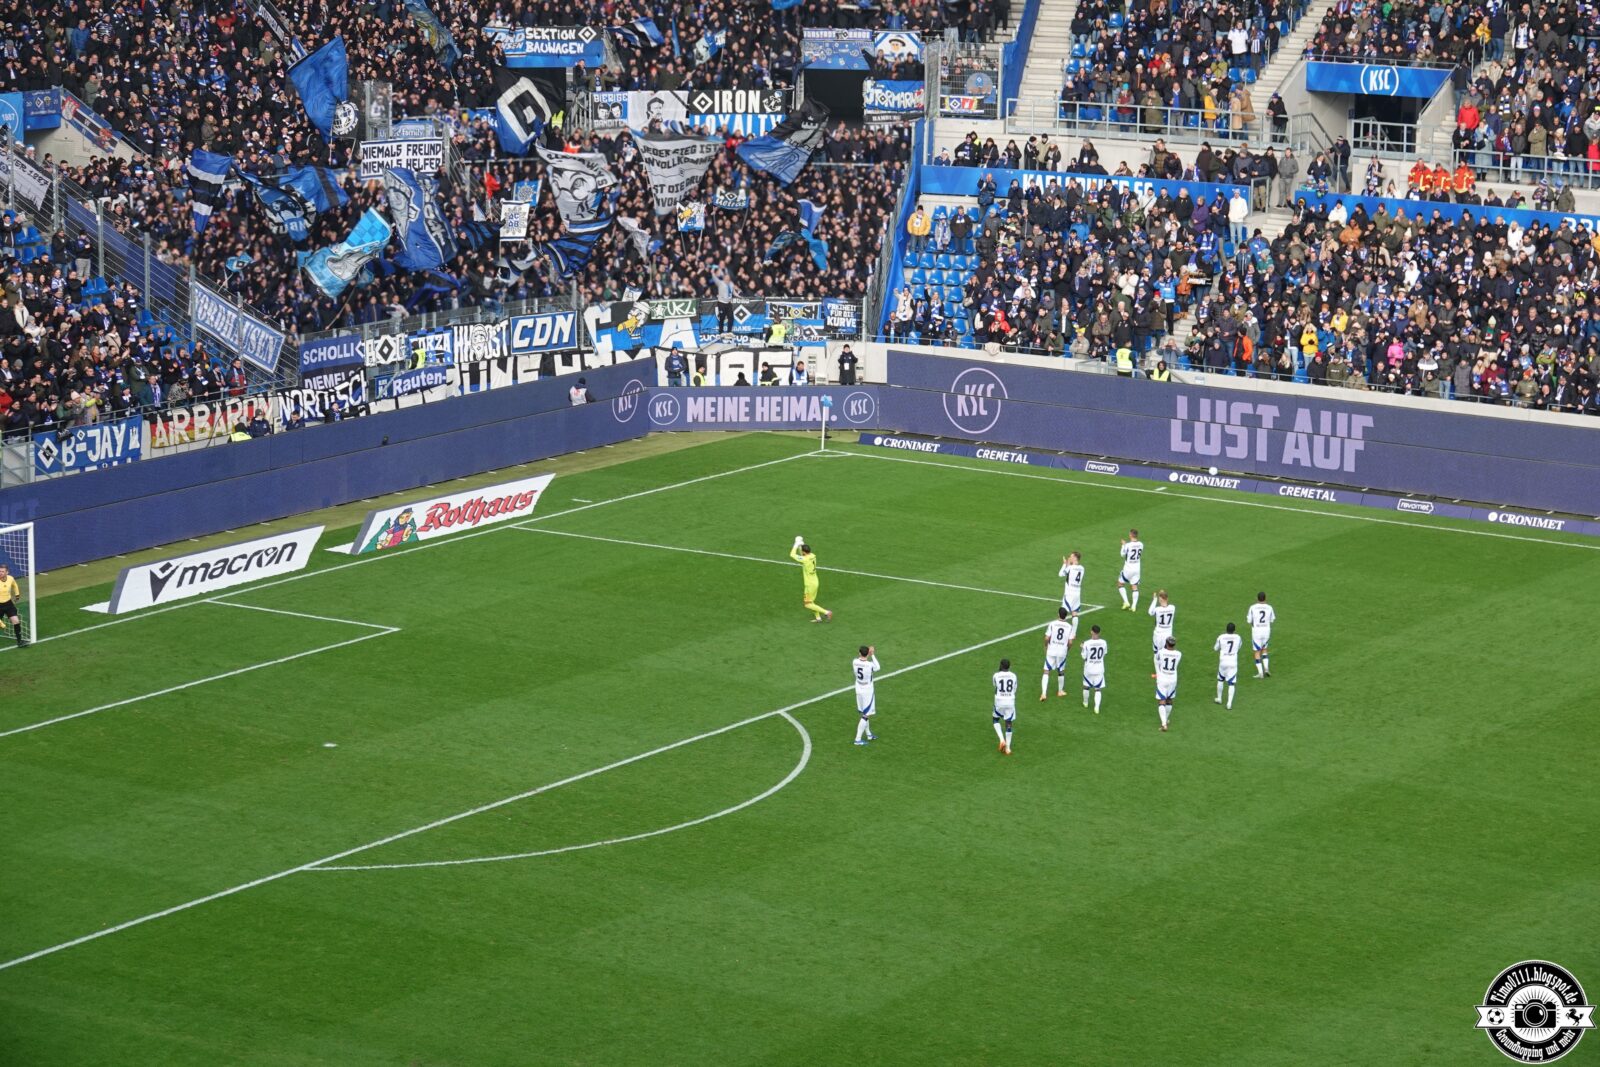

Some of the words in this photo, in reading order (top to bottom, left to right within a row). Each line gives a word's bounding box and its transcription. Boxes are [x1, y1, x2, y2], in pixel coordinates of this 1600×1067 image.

[525, 27, 576, 41] SEKTION
[525, 41, 584, 54] BAUWAGEN
[1369, 69, 1391, 91] KSC
[714, 90, 760, 114] IRON
[363, 144, 402, 160] NIEMALS
[407, 143, 442, 157] FREUND
[826, 316, 857, 328] KURVE
[513, 313, 574, 348] CDN
[303, 342, 355, 366] SCHOLLI
[957, 384, 995, 416] KSC
[655, 400, 673, 418] KSC
[686, 396, 750, 422] MEINE
[850, 398, 868, 416] KSC
[1169, 394, 1281, 463] LUST
[1282, 407, 1374, 473] AUF
[882, 437, 940, 453] CRONIMET
[976, 448, 1029, 464] CREMETAL
[1179, 473, 1240, 490] CRONIMET
[1278, 484, 1337, 502] CREMETAL
[416, 489, 538, 533] Rothaus
[1498, 512, 1565, 531] CRONIMET
[176, 541, 298, 588] macron
[1075, 571, 1081, 583] 4
[1158, 613, 1173, 625] 17
[1259, 610, 1266, 623] 2
[1056, 627, 1064, 640] 8
[1089, 646, 1104, 660] 20
[1226, 640, 1234, 653] 7
[1162, 657, 1176, 671] 11
[857, 667, 864, 681] 5
[999, 679, 1014, 693] 18
